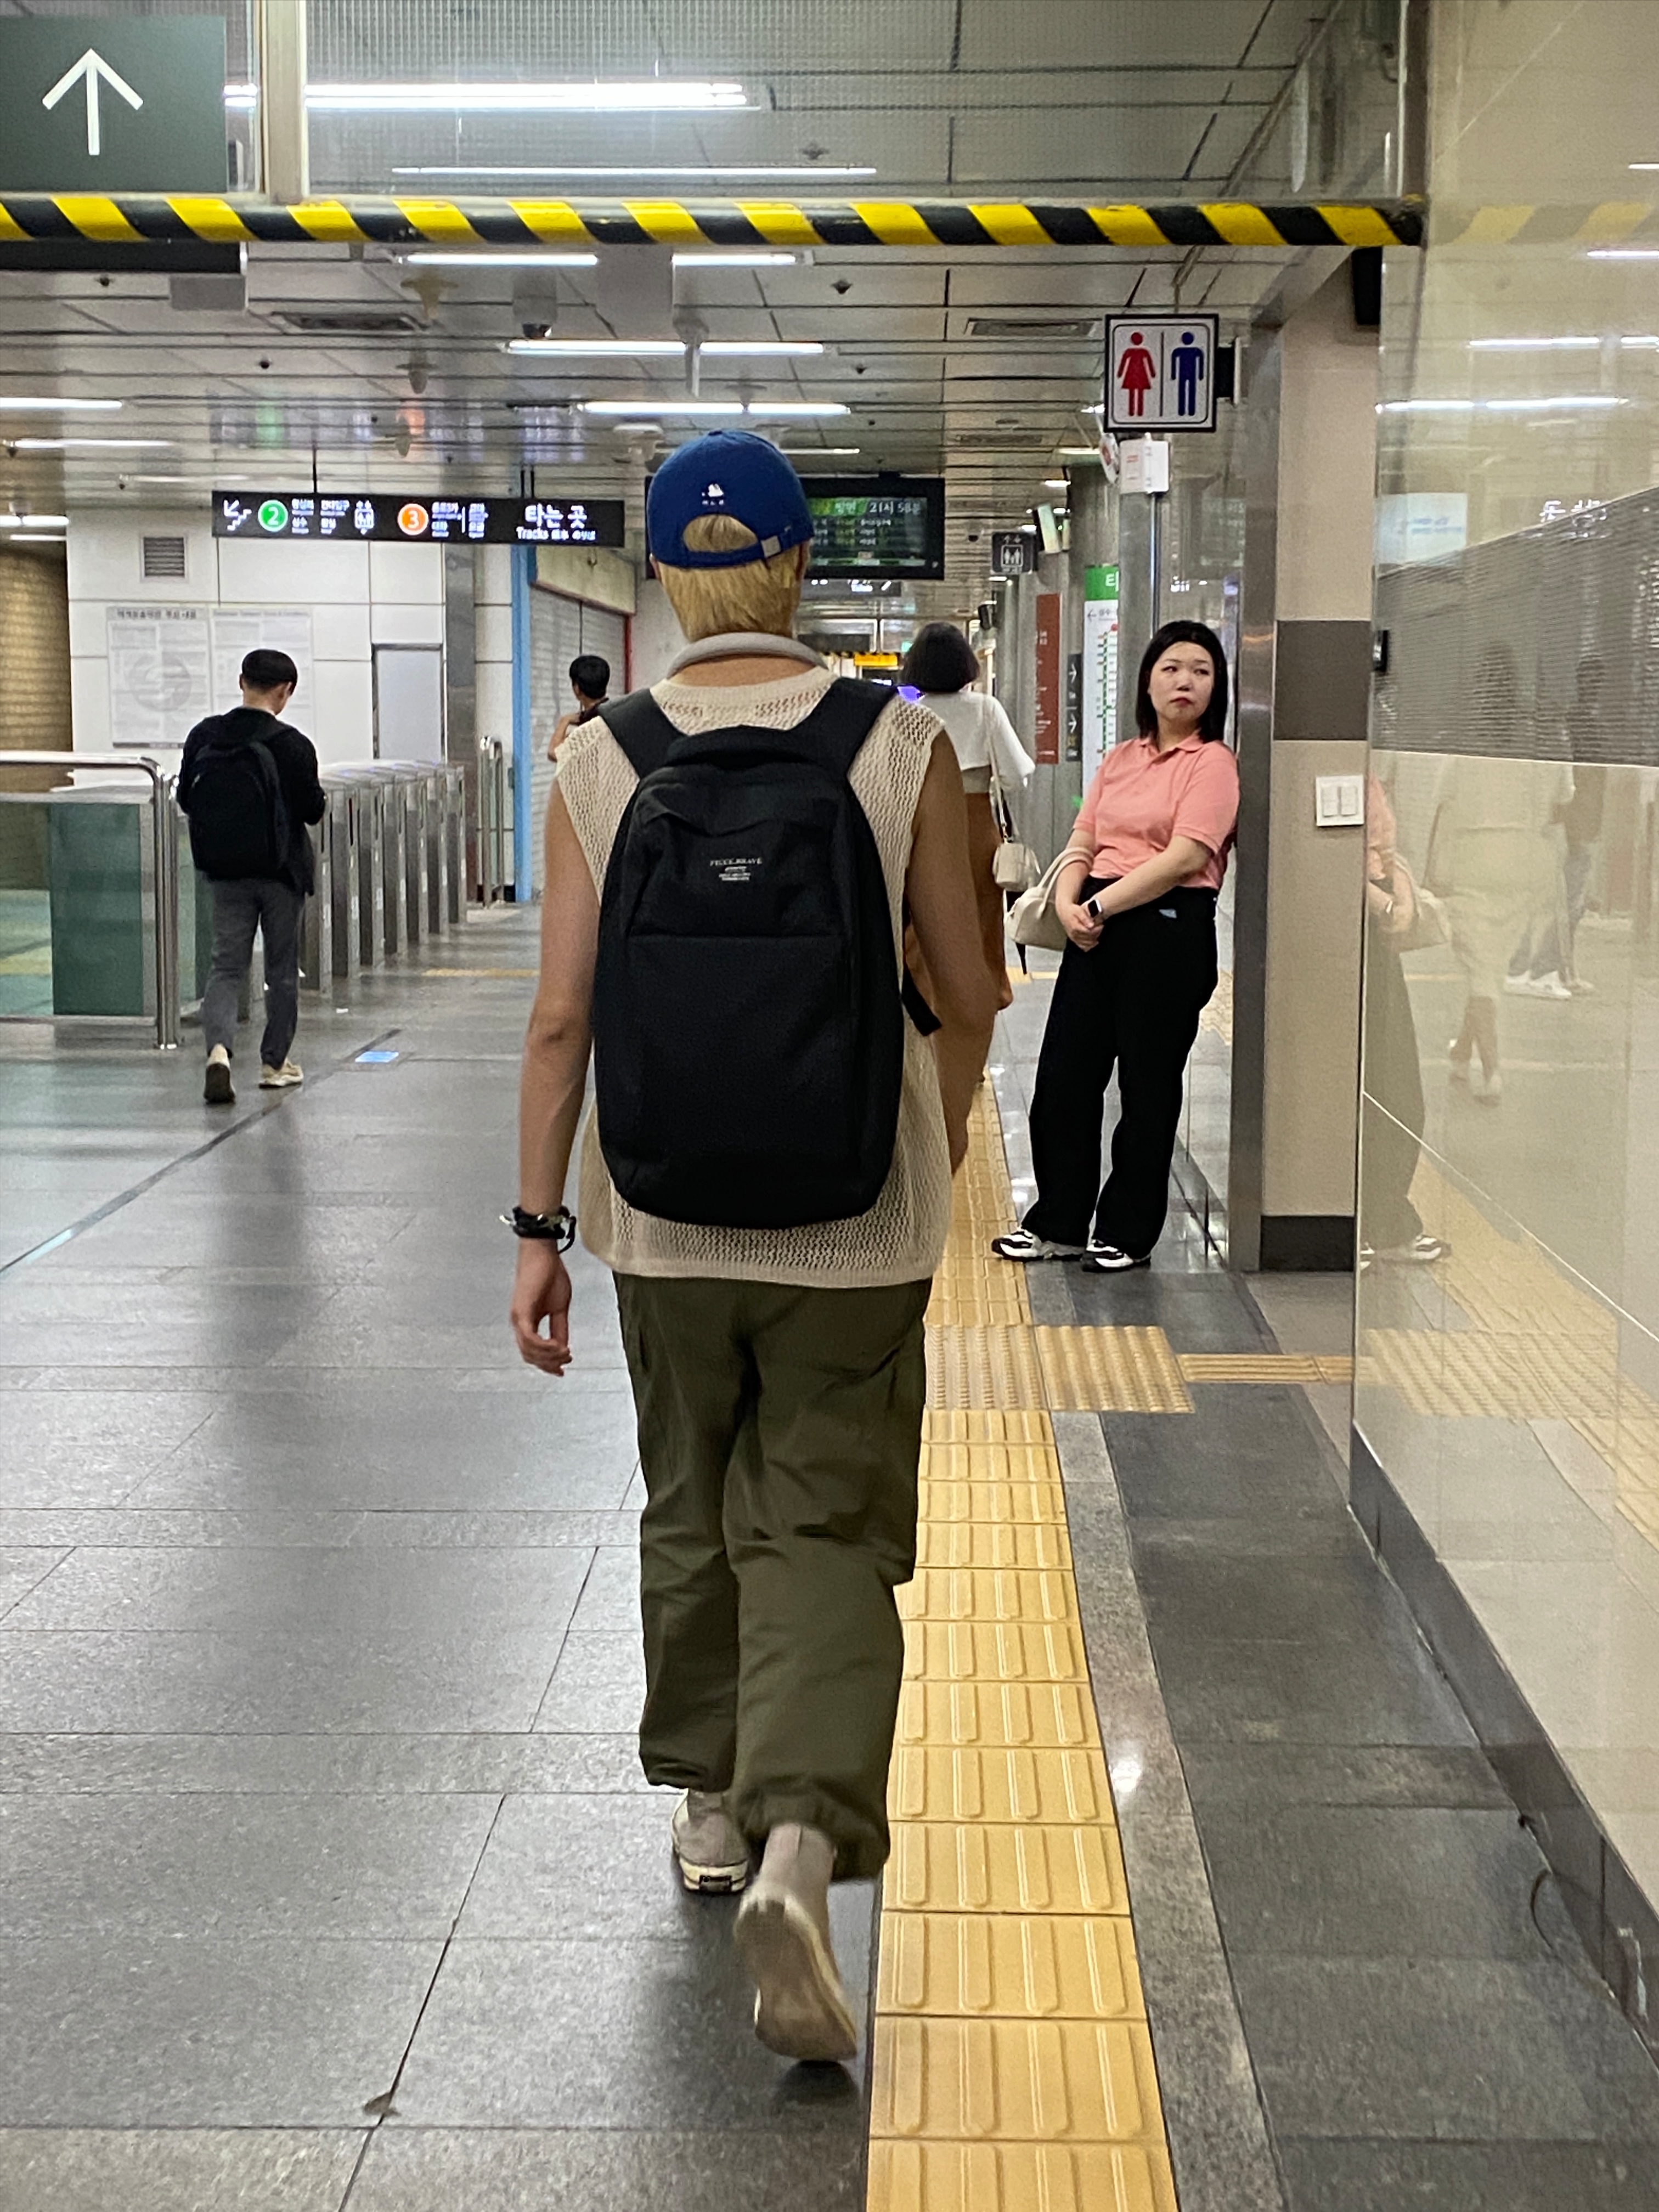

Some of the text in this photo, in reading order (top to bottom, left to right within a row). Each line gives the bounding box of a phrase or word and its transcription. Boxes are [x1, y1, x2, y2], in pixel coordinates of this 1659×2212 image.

[267, 506, 279, 525] 2
[408, 510, 419, 529] 3
[525, 503, 588, 529] 타는 곳
